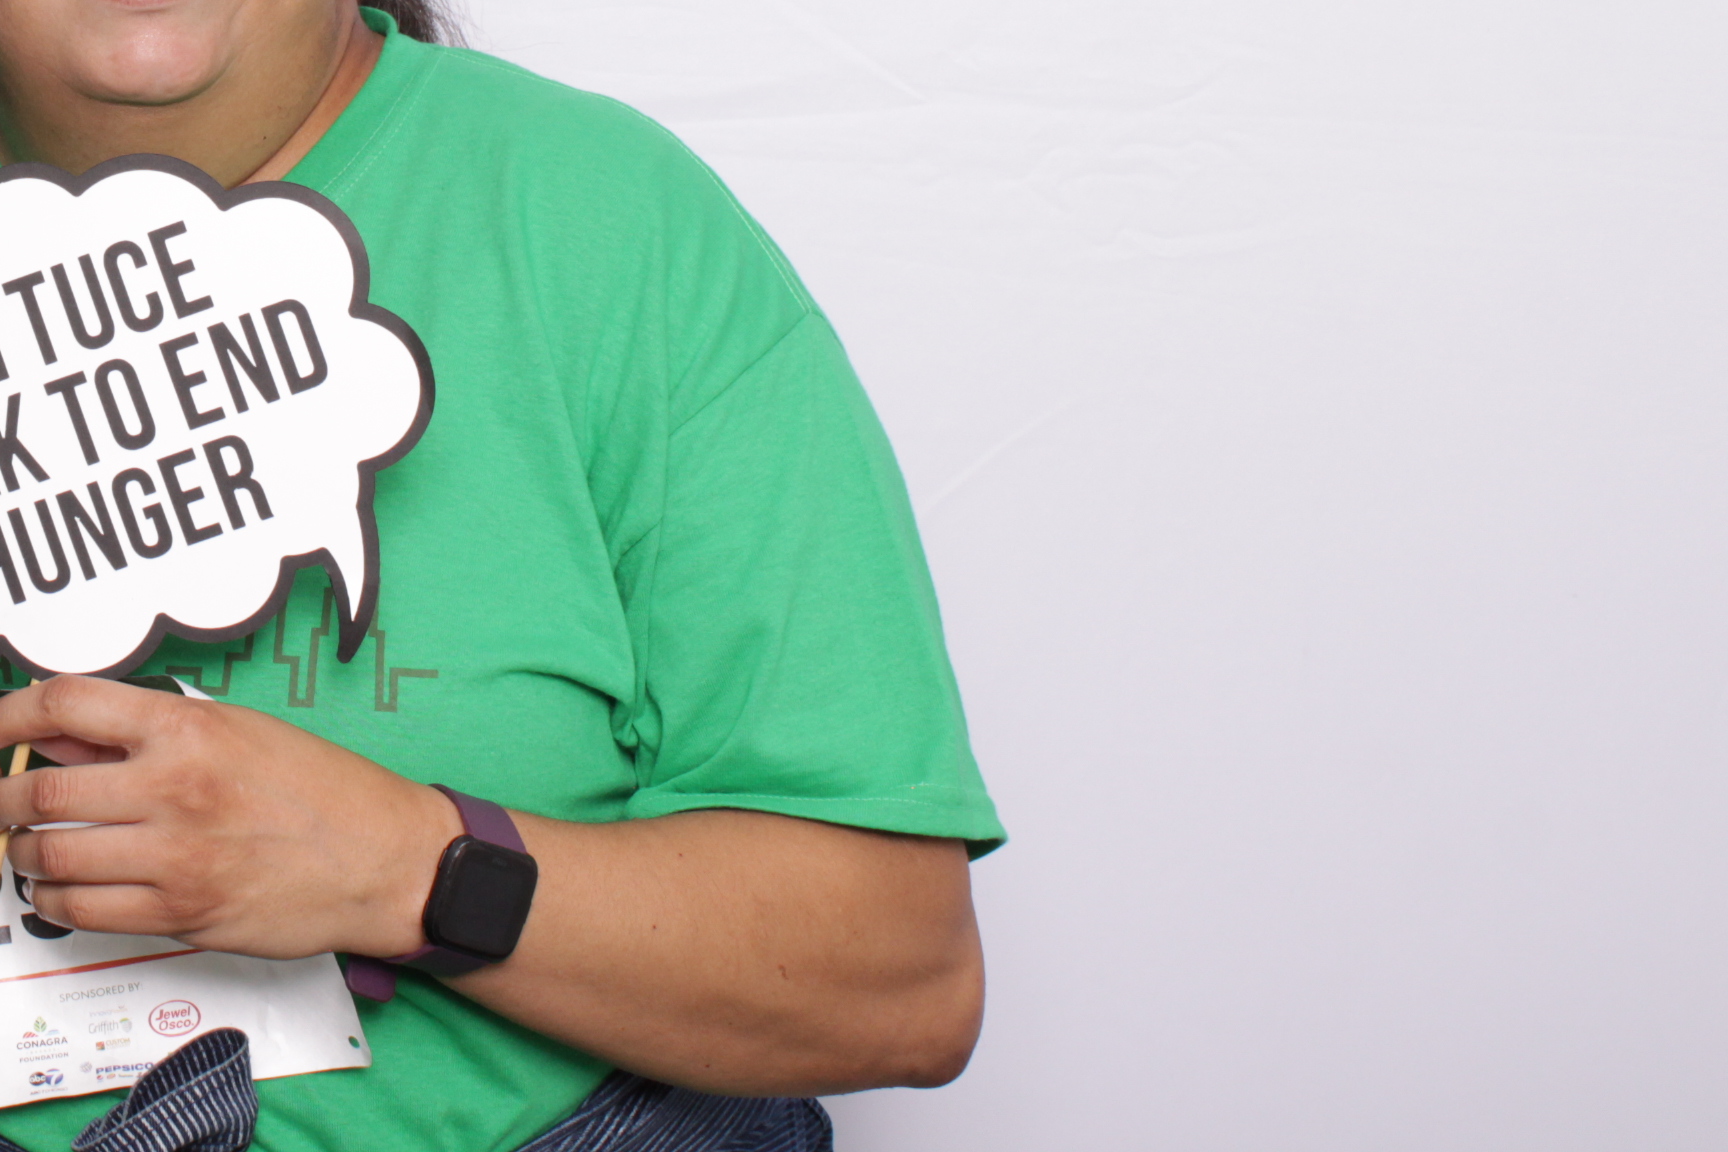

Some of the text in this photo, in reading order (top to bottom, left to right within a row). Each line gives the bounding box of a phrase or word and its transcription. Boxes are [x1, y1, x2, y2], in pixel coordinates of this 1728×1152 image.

[43, 358, 156, 466] TO
[159, 299, 328, 430] END
[59, 984, 125, 1003] SPONSORED
[155, 1006, 192, 1021] Jewel
[88, 1019, 119, 1035] Griffith
[16, 1036, 68, 1050] CONAGRA
[19, 1052, 69, 1063] FOUNDATION
[95, 1061, 154, 1075] PEPSICO
